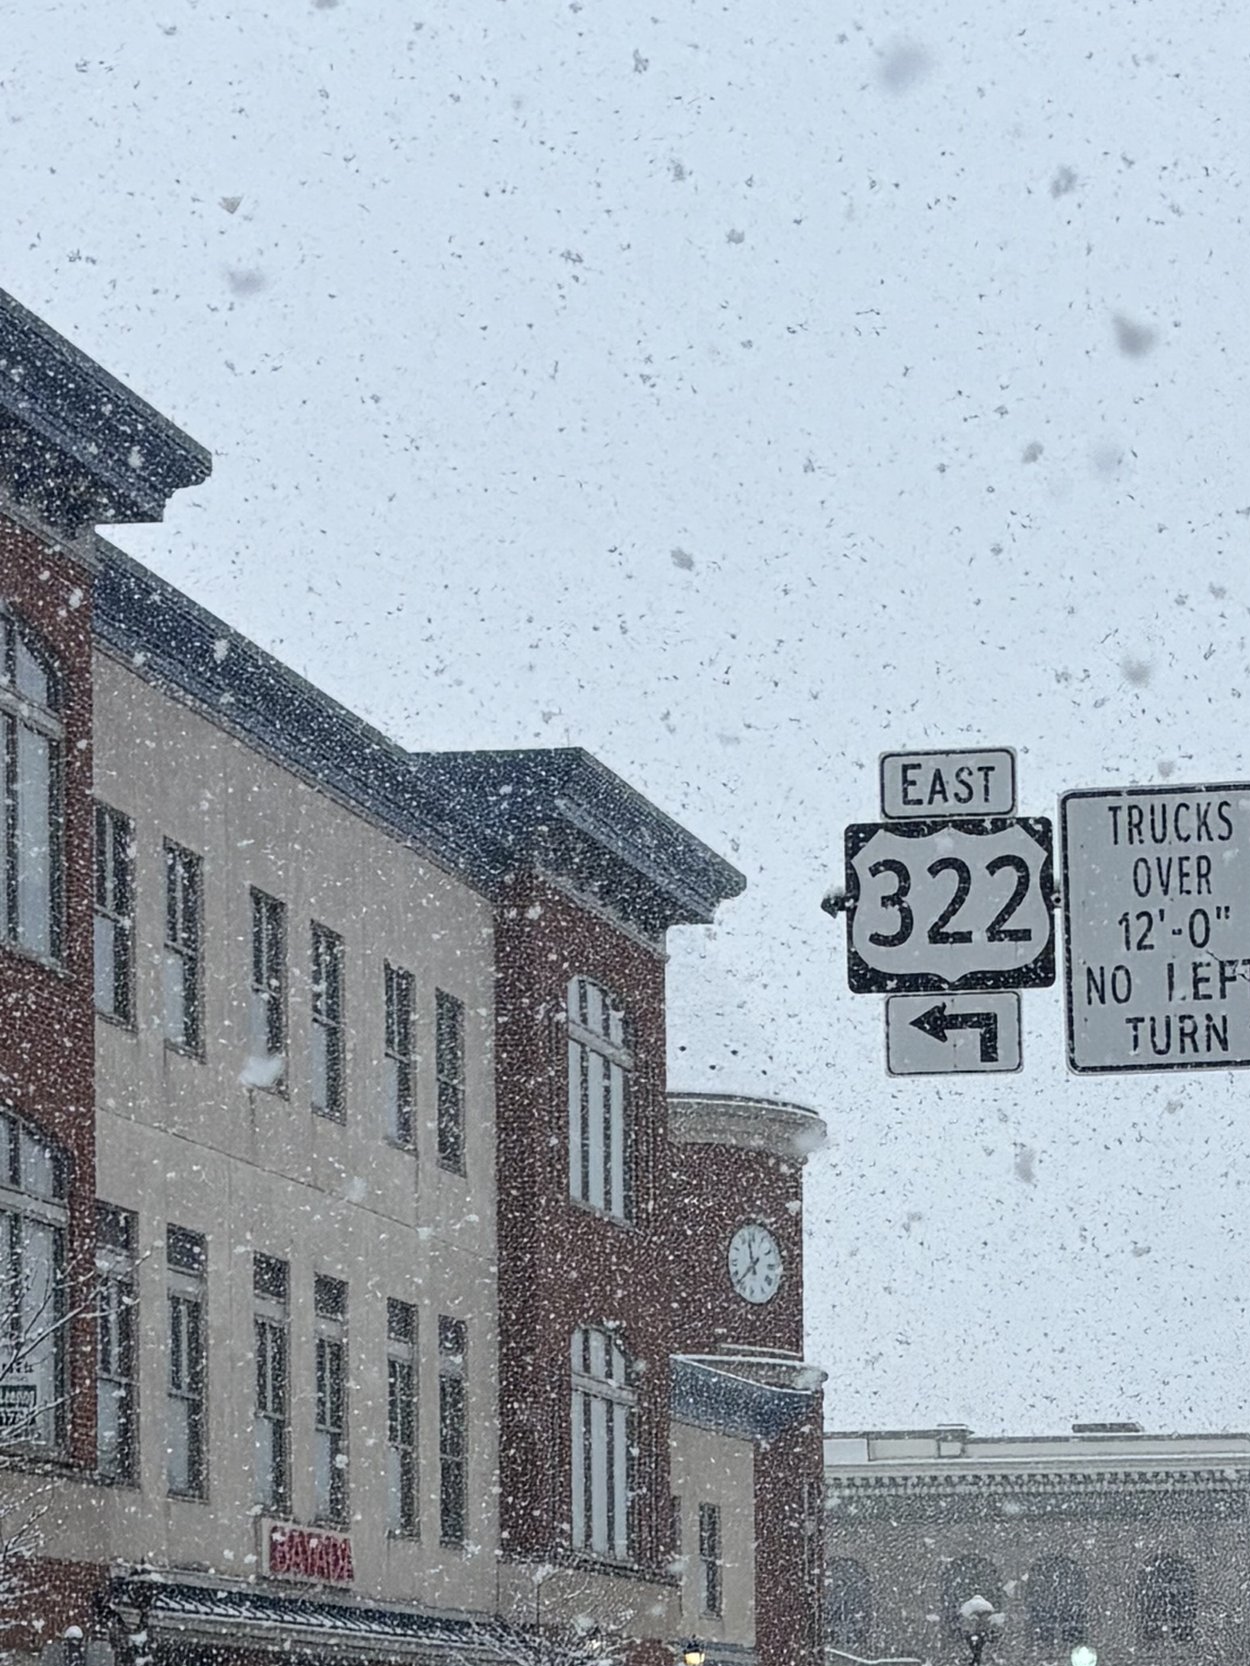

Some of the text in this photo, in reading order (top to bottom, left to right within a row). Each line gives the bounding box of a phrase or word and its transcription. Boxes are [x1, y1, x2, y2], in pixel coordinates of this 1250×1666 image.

[901, 763, 996, 806] EAST
[1108, 800, 1233, 845] TRUCKS
[1133, 855, 1212, 898] OVER
[868, 854, 1032, 948] 322
[1118, 906, 1231, 951] 12'-0"
[1086, 964, 1132, 1006] NO
[1125, 1013, 1230, 1056] TURN
